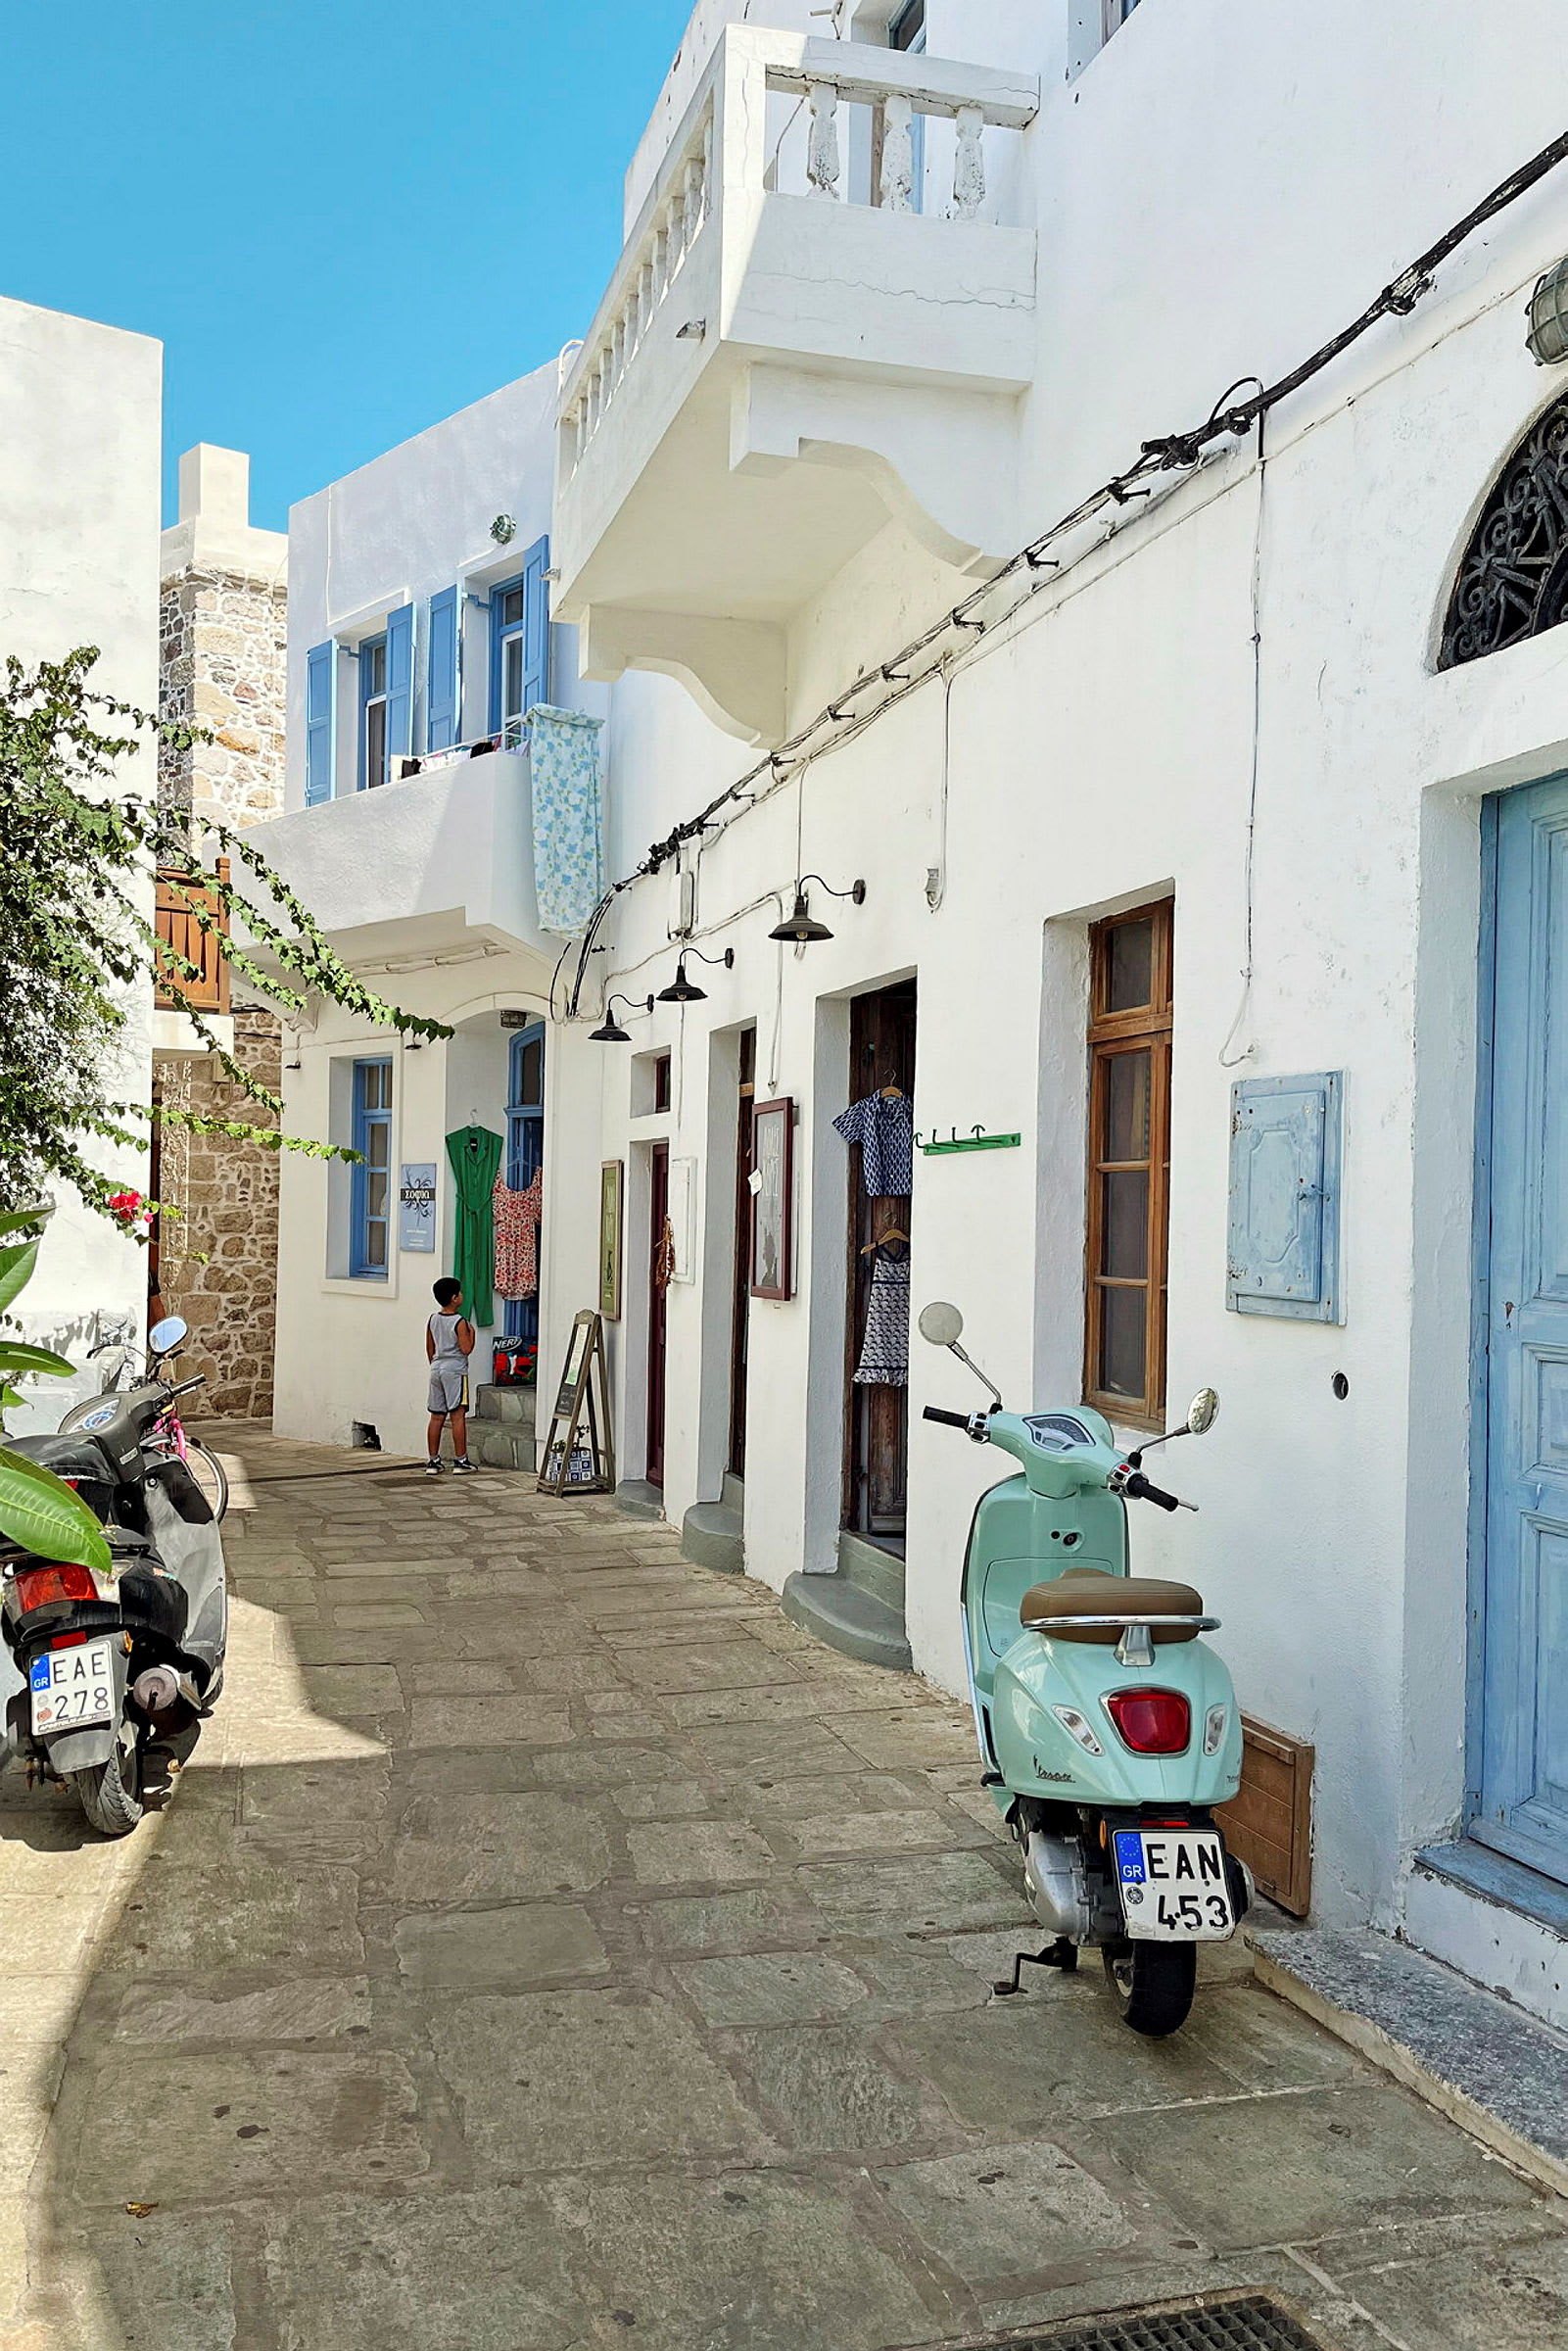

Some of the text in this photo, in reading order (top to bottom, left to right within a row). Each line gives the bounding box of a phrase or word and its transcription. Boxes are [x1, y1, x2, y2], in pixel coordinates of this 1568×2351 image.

[34, 1677, 48, 1688] GR
[53, 1653, 106, 1683] EAE
[55, 1687, 108, 1720] 278
[1122, 1865, 1144, 1878] GR
[1146, 1844, 1221, 1880] EAN
[1158, 1895, 1229, 1931] 453
